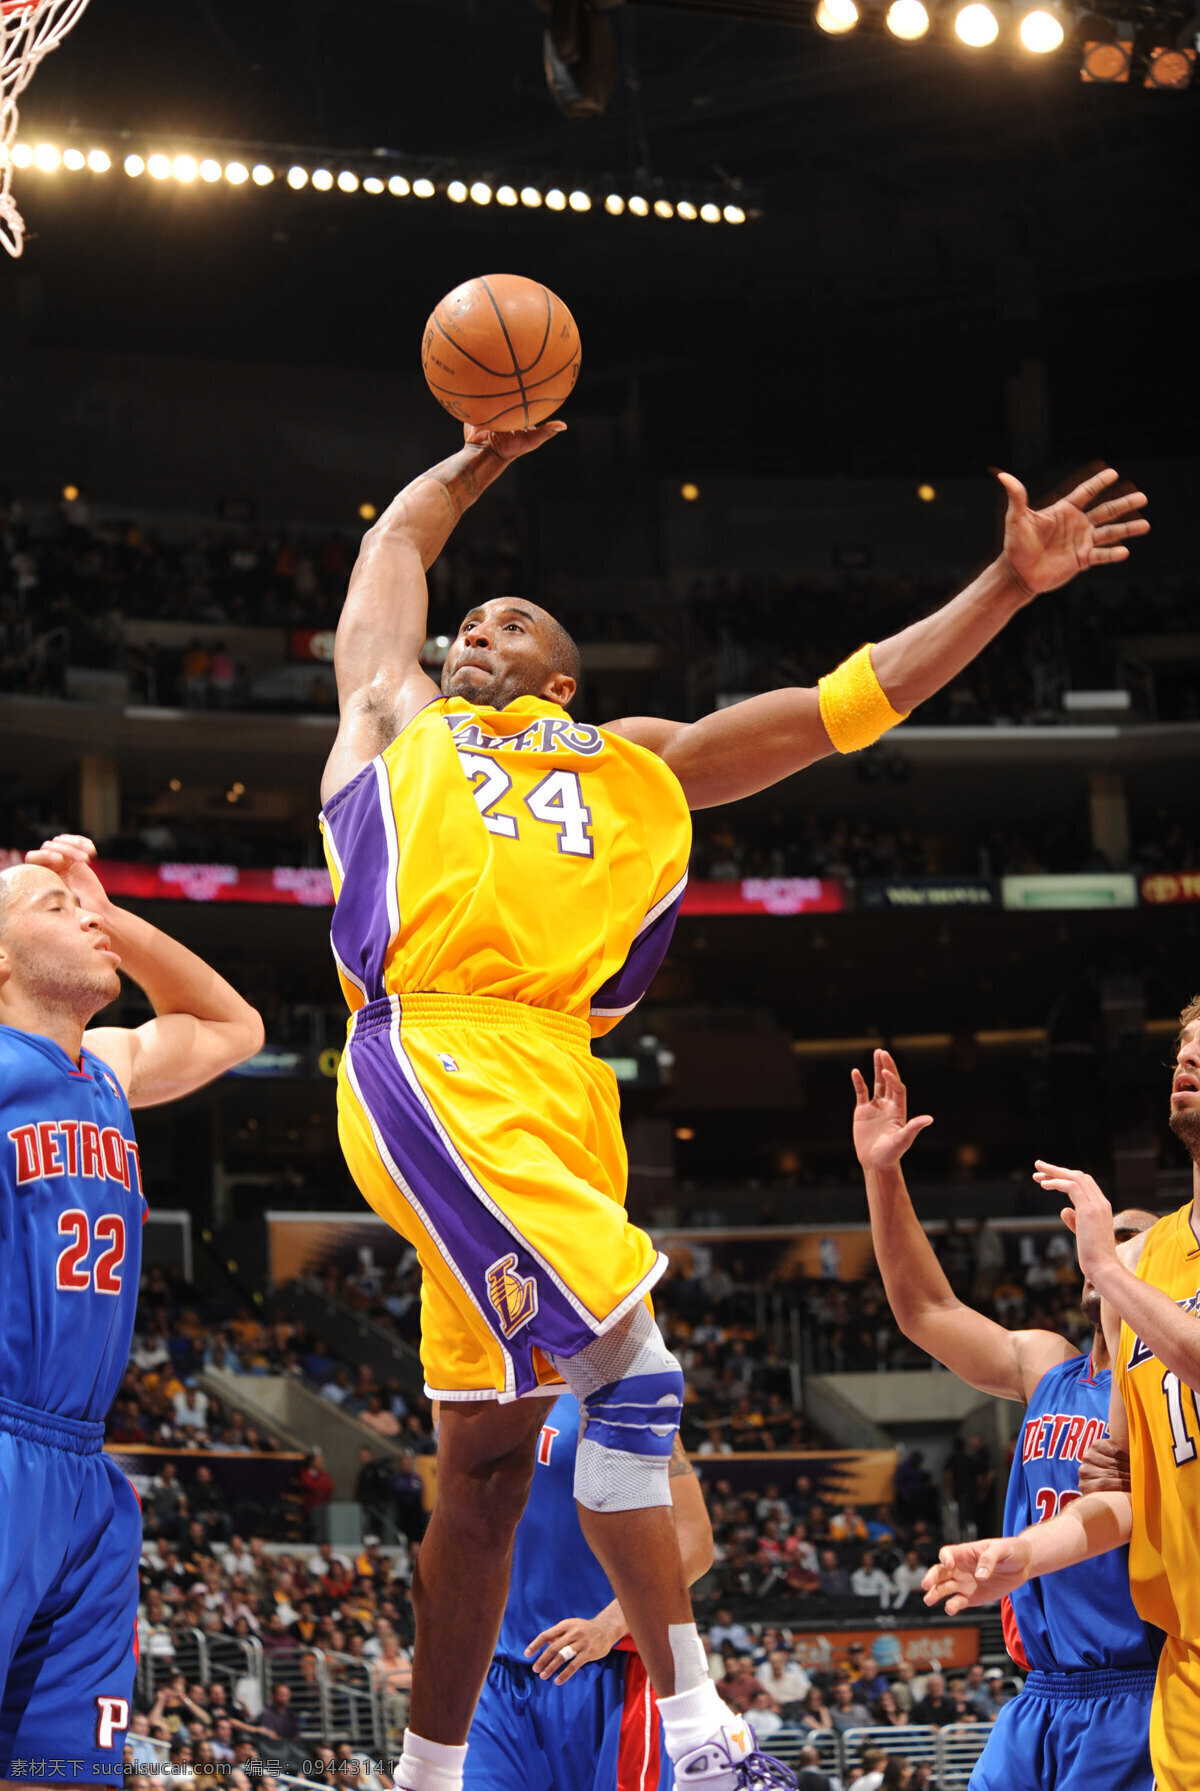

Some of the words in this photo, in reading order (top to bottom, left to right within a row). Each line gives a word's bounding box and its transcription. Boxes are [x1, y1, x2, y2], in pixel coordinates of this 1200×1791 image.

[458, 750, 594, 859] 24
[7, 1120, 143, 1199] DETROIT
[56, 1208, 126, 1296] 22
[1161, 1369, 1200, 1468] 1
